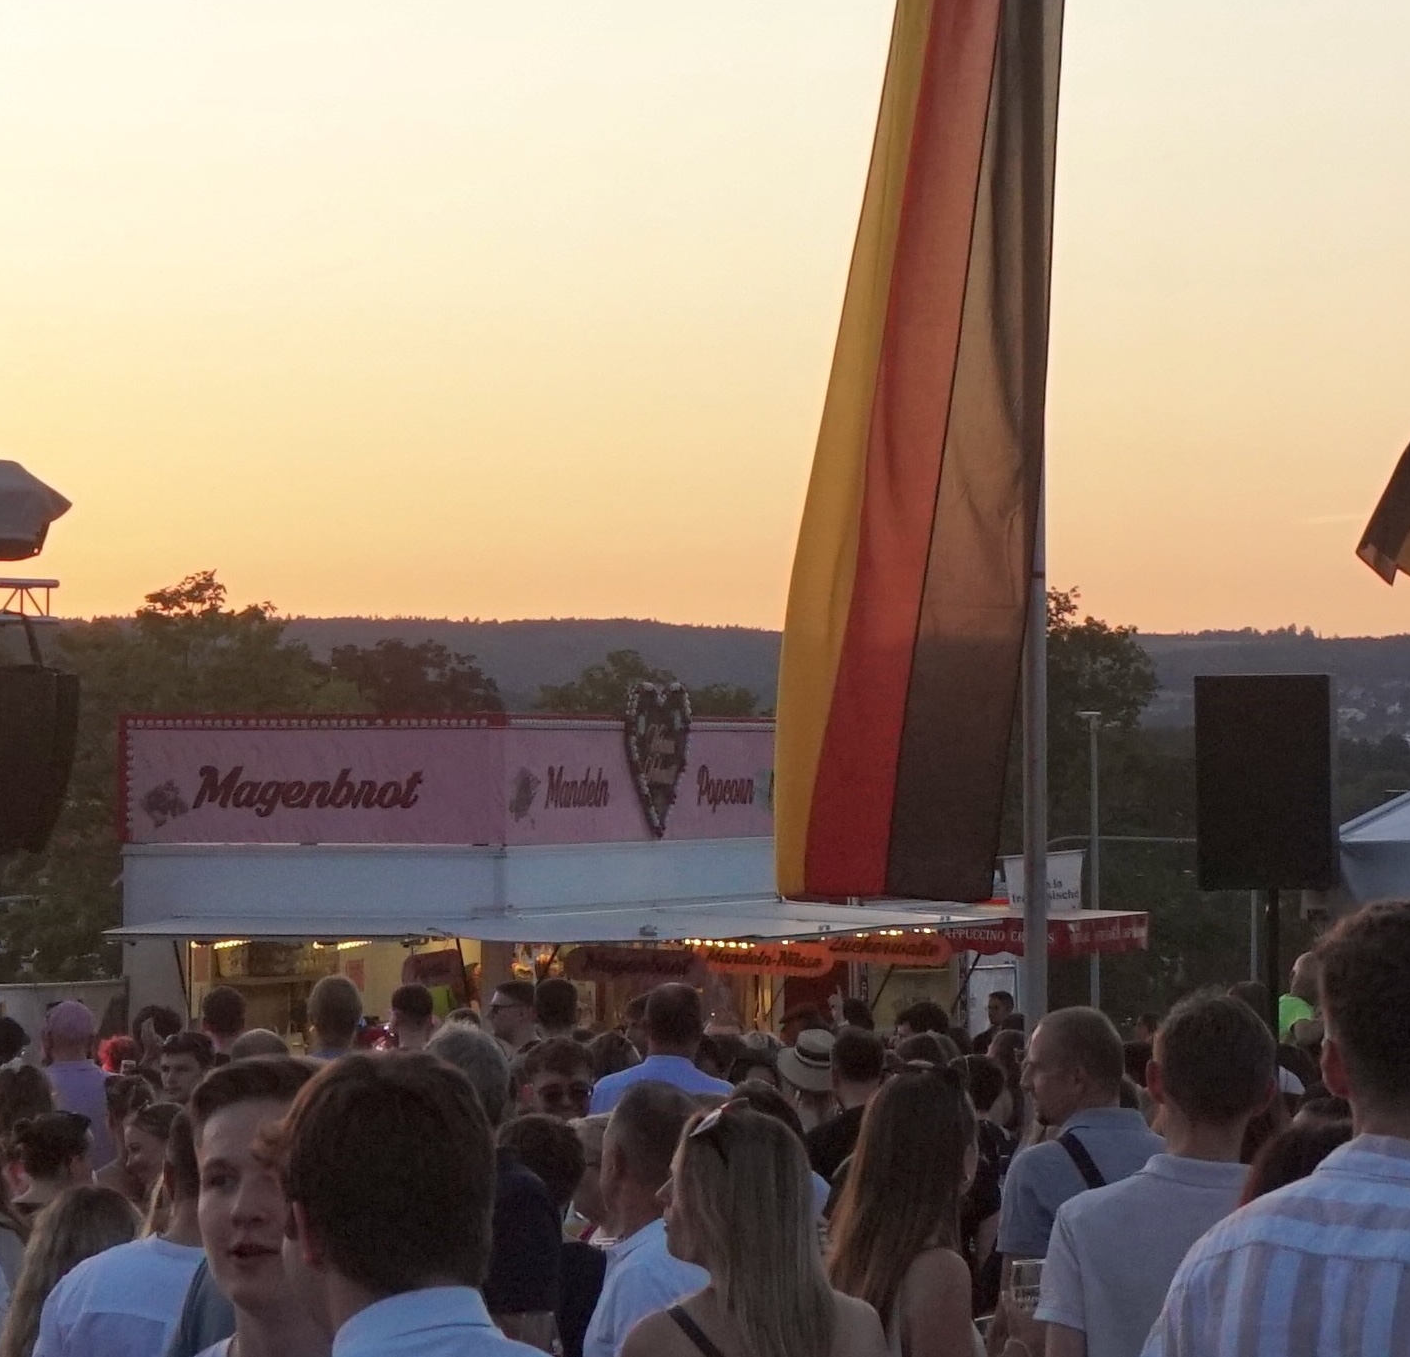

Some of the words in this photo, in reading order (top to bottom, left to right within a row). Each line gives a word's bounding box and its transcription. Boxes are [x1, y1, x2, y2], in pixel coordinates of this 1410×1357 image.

[191, 765, 424, 818] Magenbrot
[544, 765, 610, 810] Mandeln
[696, 764, 755, 814] Popcorn
[942, 927, 1006, 942] APPUCCINO
